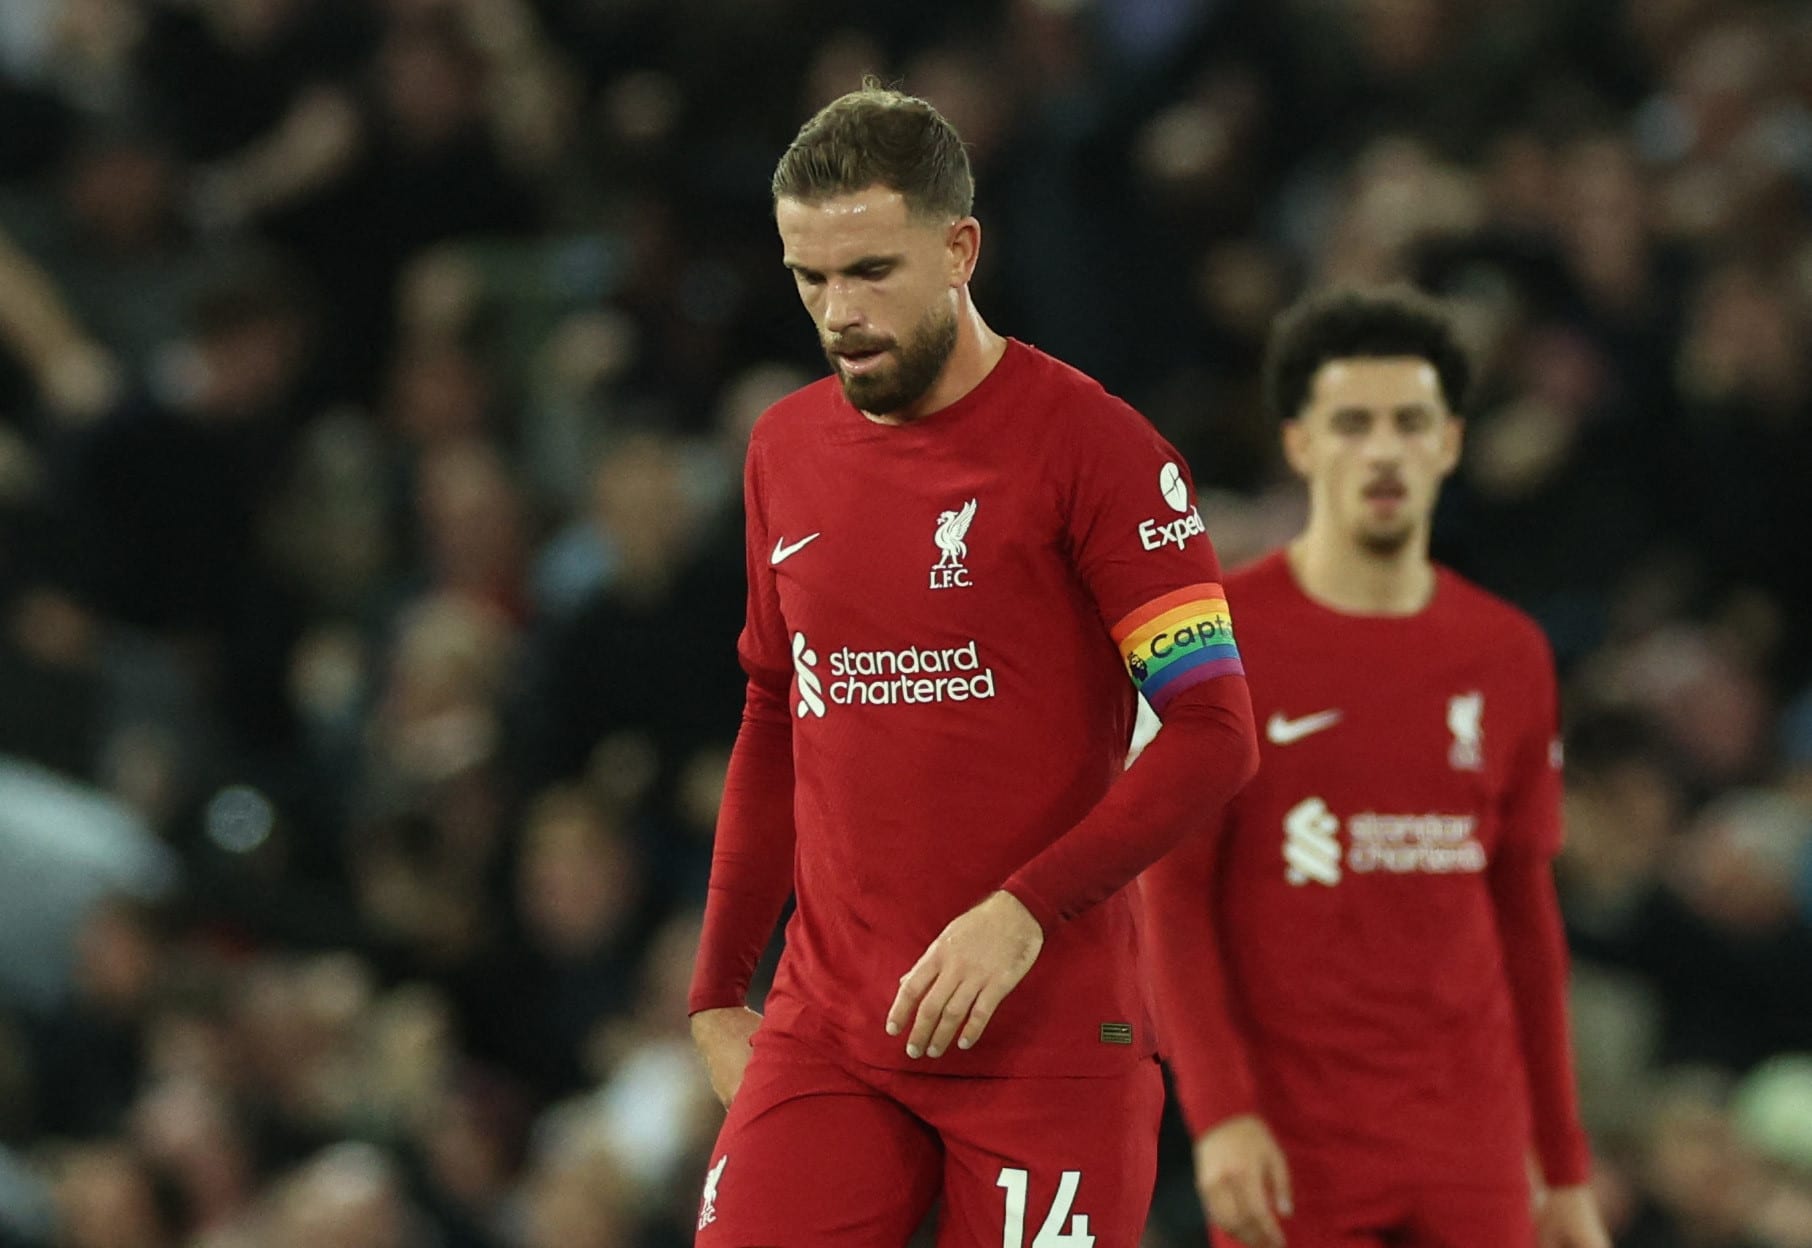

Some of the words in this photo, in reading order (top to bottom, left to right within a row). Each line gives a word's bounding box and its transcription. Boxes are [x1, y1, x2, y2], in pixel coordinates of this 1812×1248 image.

[1150, 613, 1233, 659] Capt
[829, 640, 979, 676] standard
[829, 668, 995, 705] chartered
[996, 1167, 1096, 1248] 14
